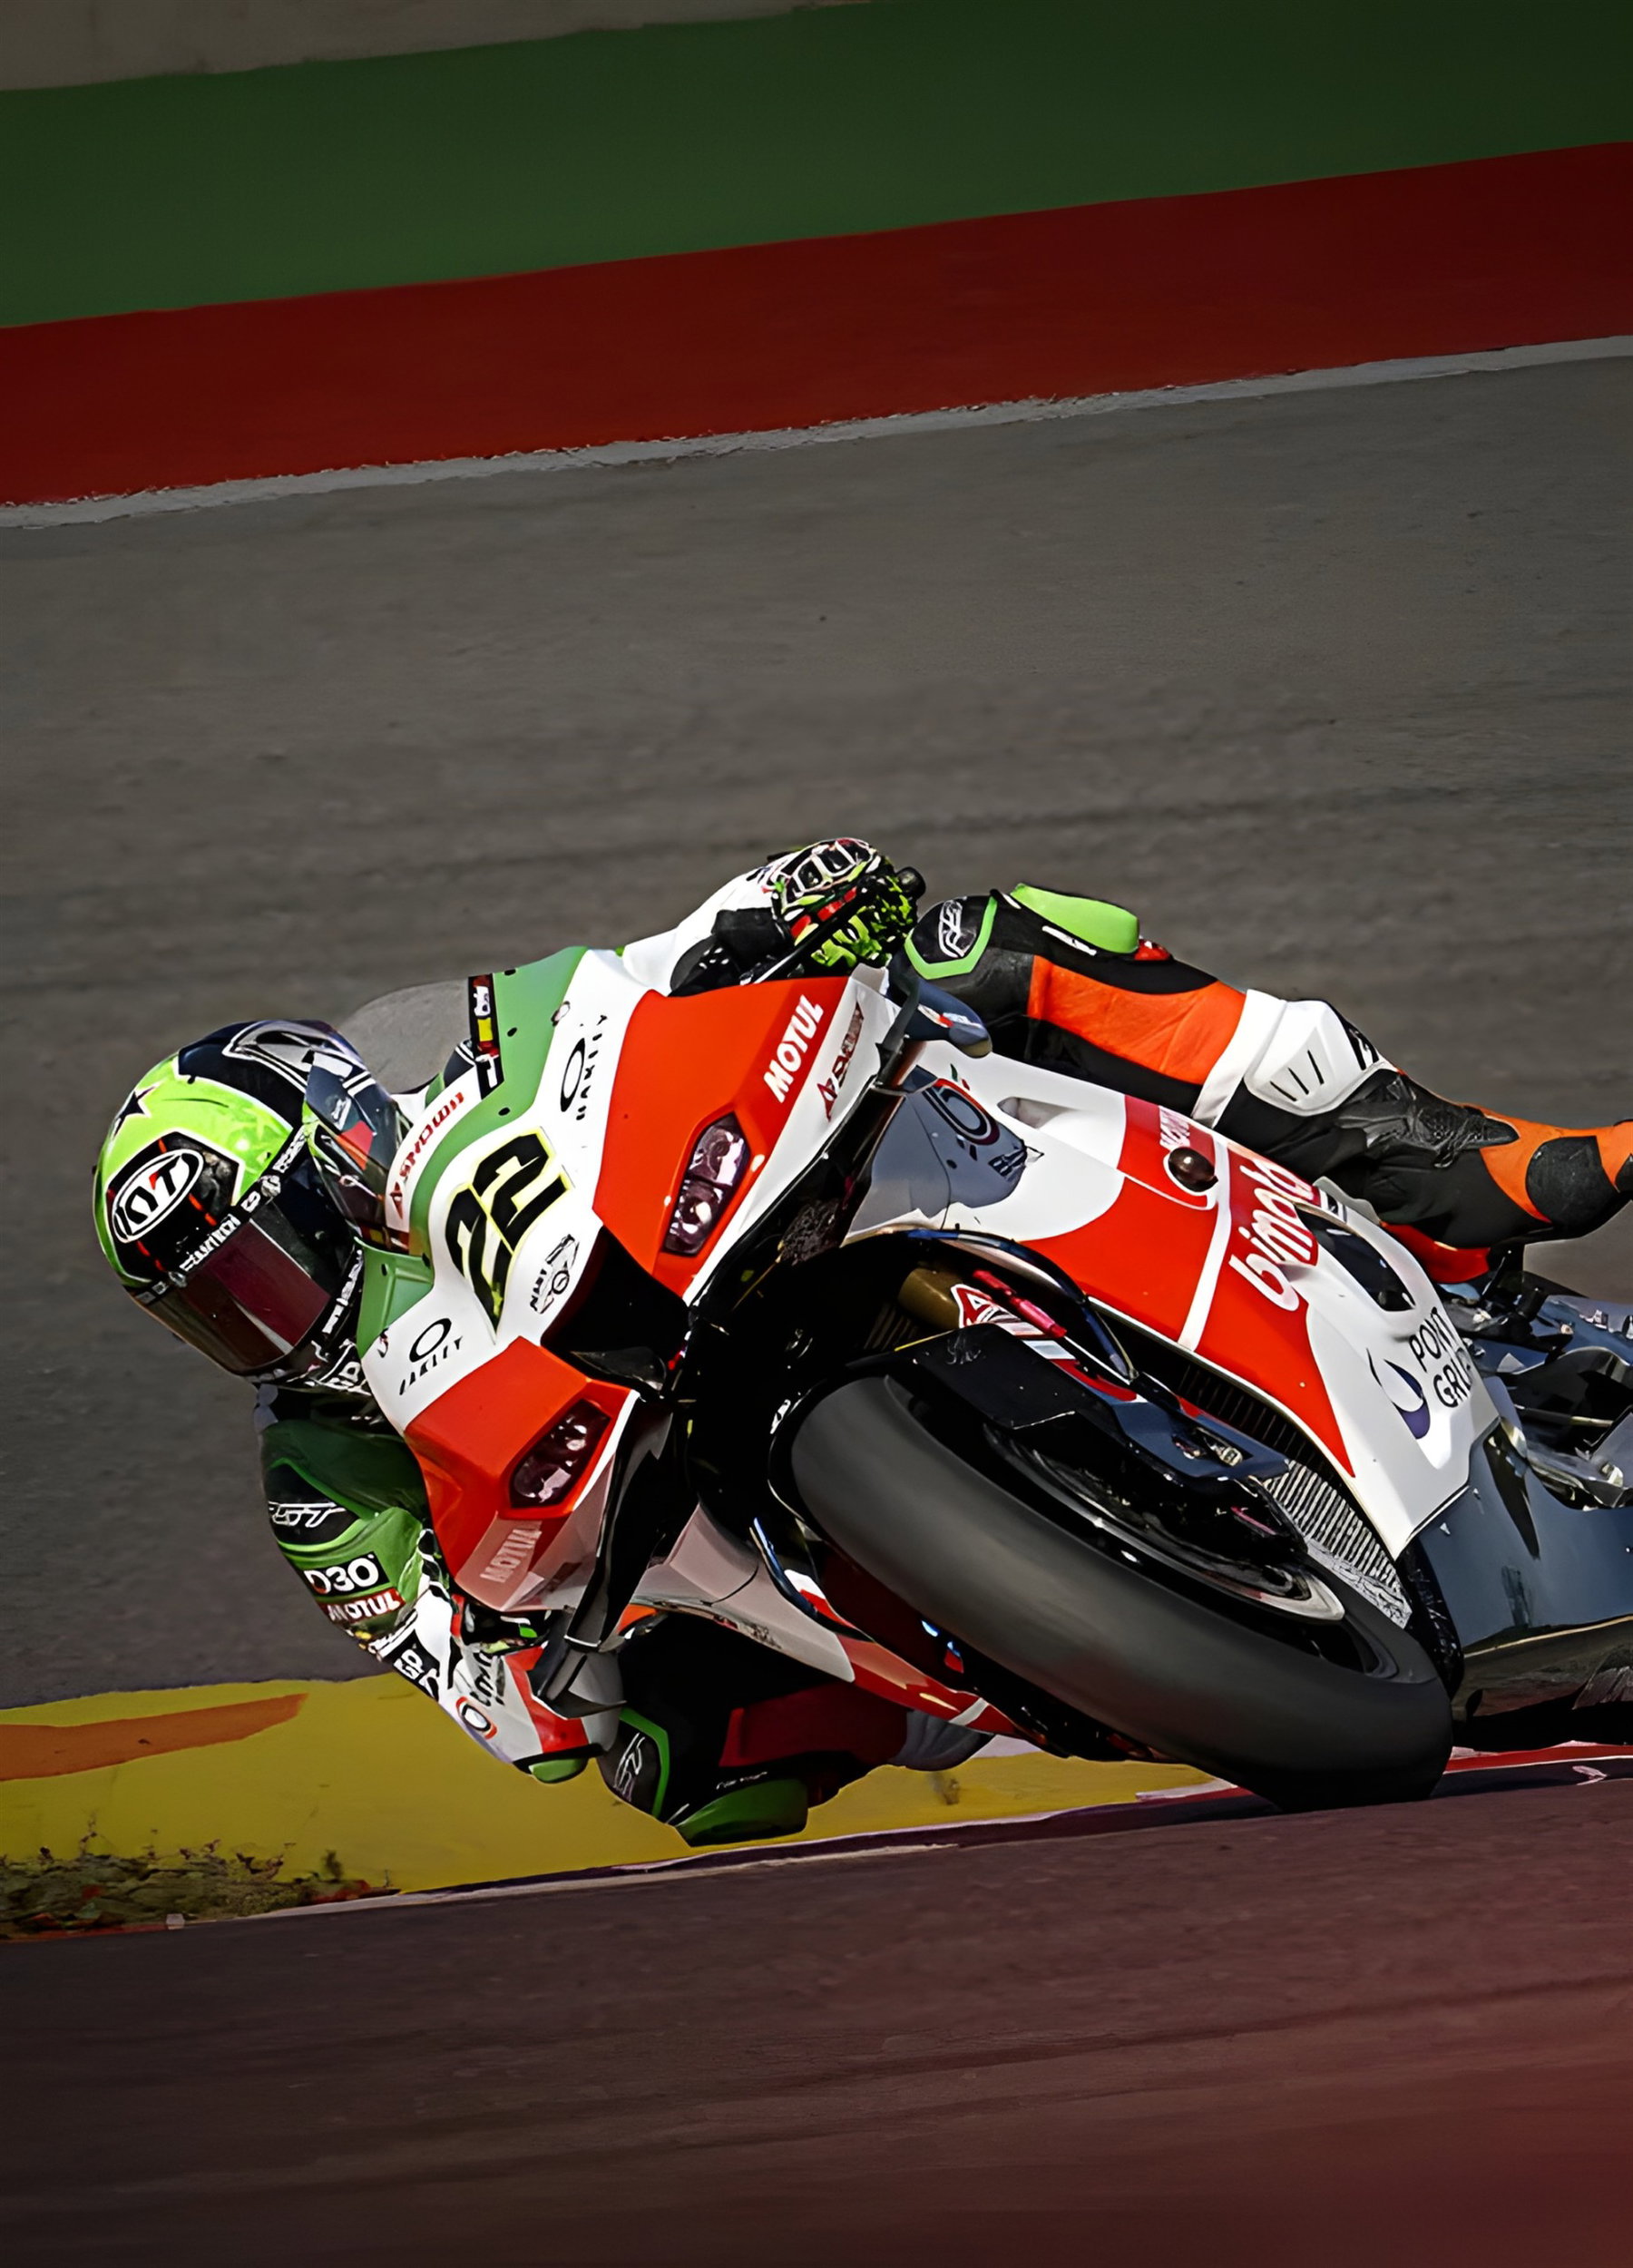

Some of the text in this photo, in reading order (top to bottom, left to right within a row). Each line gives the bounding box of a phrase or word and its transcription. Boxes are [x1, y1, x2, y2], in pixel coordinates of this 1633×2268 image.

[763, 995, 824, 1103] MOTUL
[116, 1154, 186, 1236] KYT
[445, 1131, 572, 1335] 22
